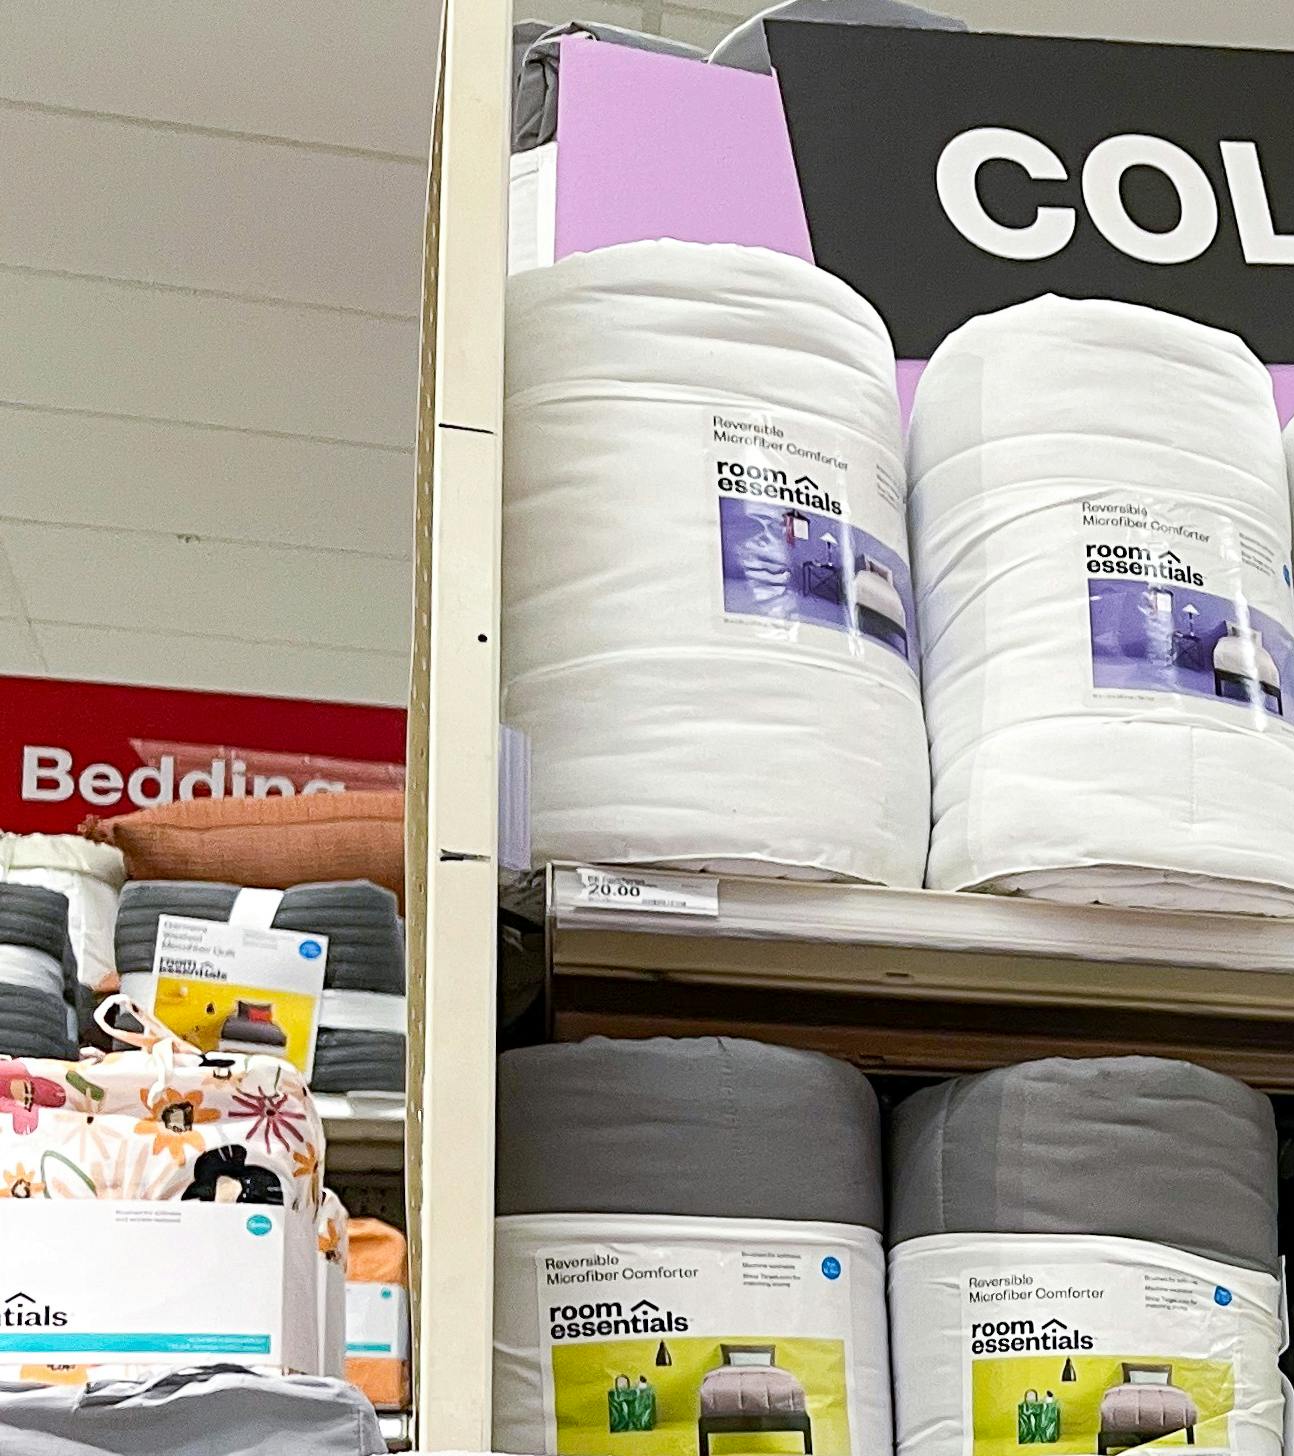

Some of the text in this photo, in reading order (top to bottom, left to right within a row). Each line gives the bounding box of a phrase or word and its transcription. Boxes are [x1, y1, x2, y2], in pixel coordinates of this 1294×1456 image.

[713, 415, 785, 439] Reversible
[713, 430, 849, 472] Microfiber Comforter
[716, 460, 787, 486] room
[717, 476, 843, 516] essentials
[1082, 501, 1148, 518] Reversible
[1082, 514, 1211, 543] Microfiber Comforter
[1085, 543, 1151, 560] room
[1086, 559, 1205, 587] essentials
[588, 884, 641, 897] 20.00
[545, 1254, 620, 1270] Reversible
[546, 1266, 699, 1286] Microfiber Comforter
[969, 1273, 1034, 1289] Reversible
[969, 1286, 1106, 1304] Microfiber Comforter
[549, 1301, 623, 1323] room
[550, 1311, 690, 1340] essentials
[971, 1319, 1035, 1339] room
[971, 1329, 1094, 1355] essentials
